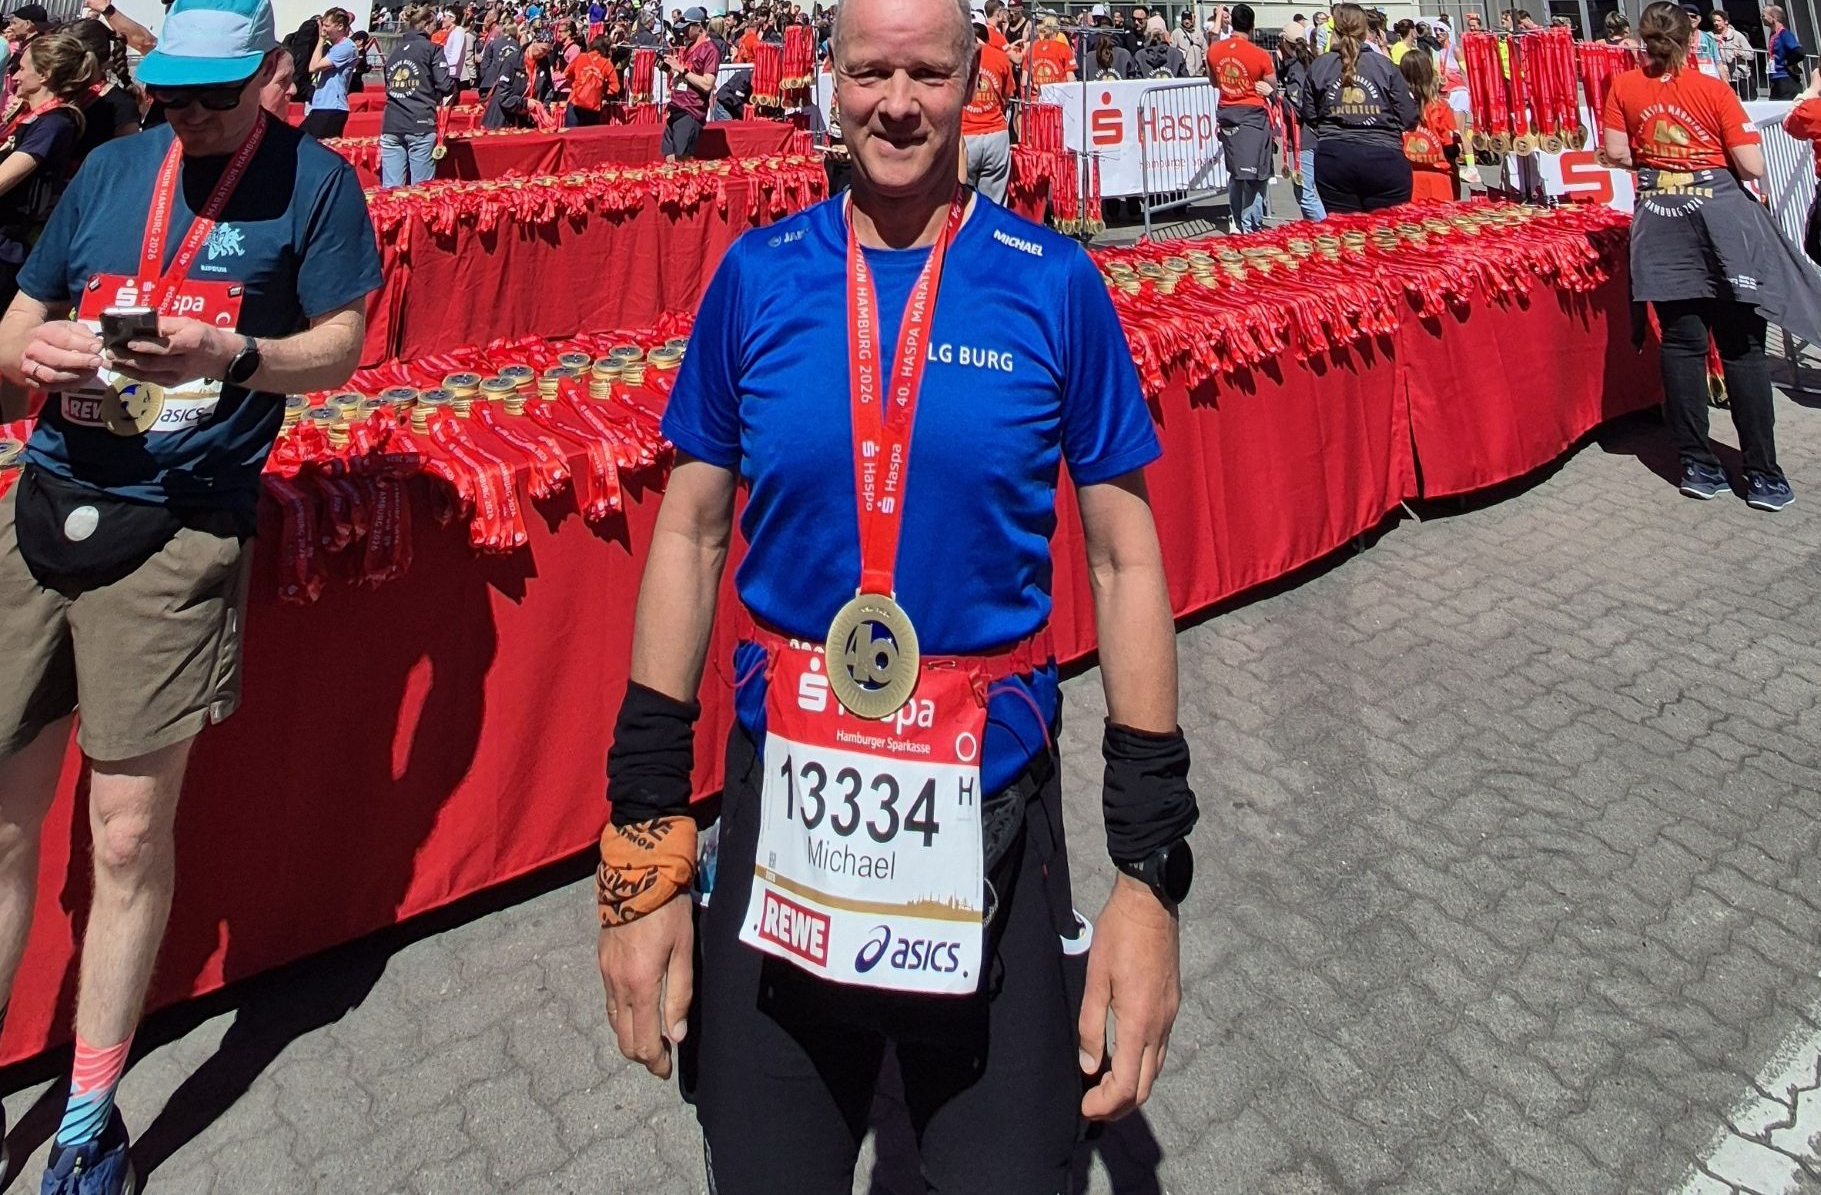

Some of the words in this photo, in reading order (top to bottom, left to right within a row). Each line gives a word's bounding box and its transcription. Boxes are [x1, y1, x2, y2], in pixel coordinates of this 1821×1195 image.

[151, 187, 168, 235] HAMBURG
[188, 218, 210, 249] HASPA
[207, 169, 239, 217] MARATHON
[1644, 199, 1684, 217] HAMBURG
[147, 236, 160, 261] 2026
[993, 228, 1044, 257] MICHAEL
[856, 286, 873, 361] HAMBURG
[900, 326, 920, 378] HASPA
[928, 341, 953, 363] LG
[959, 345, 1014, 373] BURG
[859, 365, 874, 404] 2026
[896, 381, 912, 407] 40.
[885, 443, 902, 492] Haspa
[836, 729, 886, 750] Hamburger
[887, 737, 931, 755] Sparkasse
[780, 753, 940, 848] 13334
[958, 776, 974, 806] H
[807, 835, 896, 881] Michael
[763, 897, 826, 959] REWE
[890, 937, 961, 974] asics
